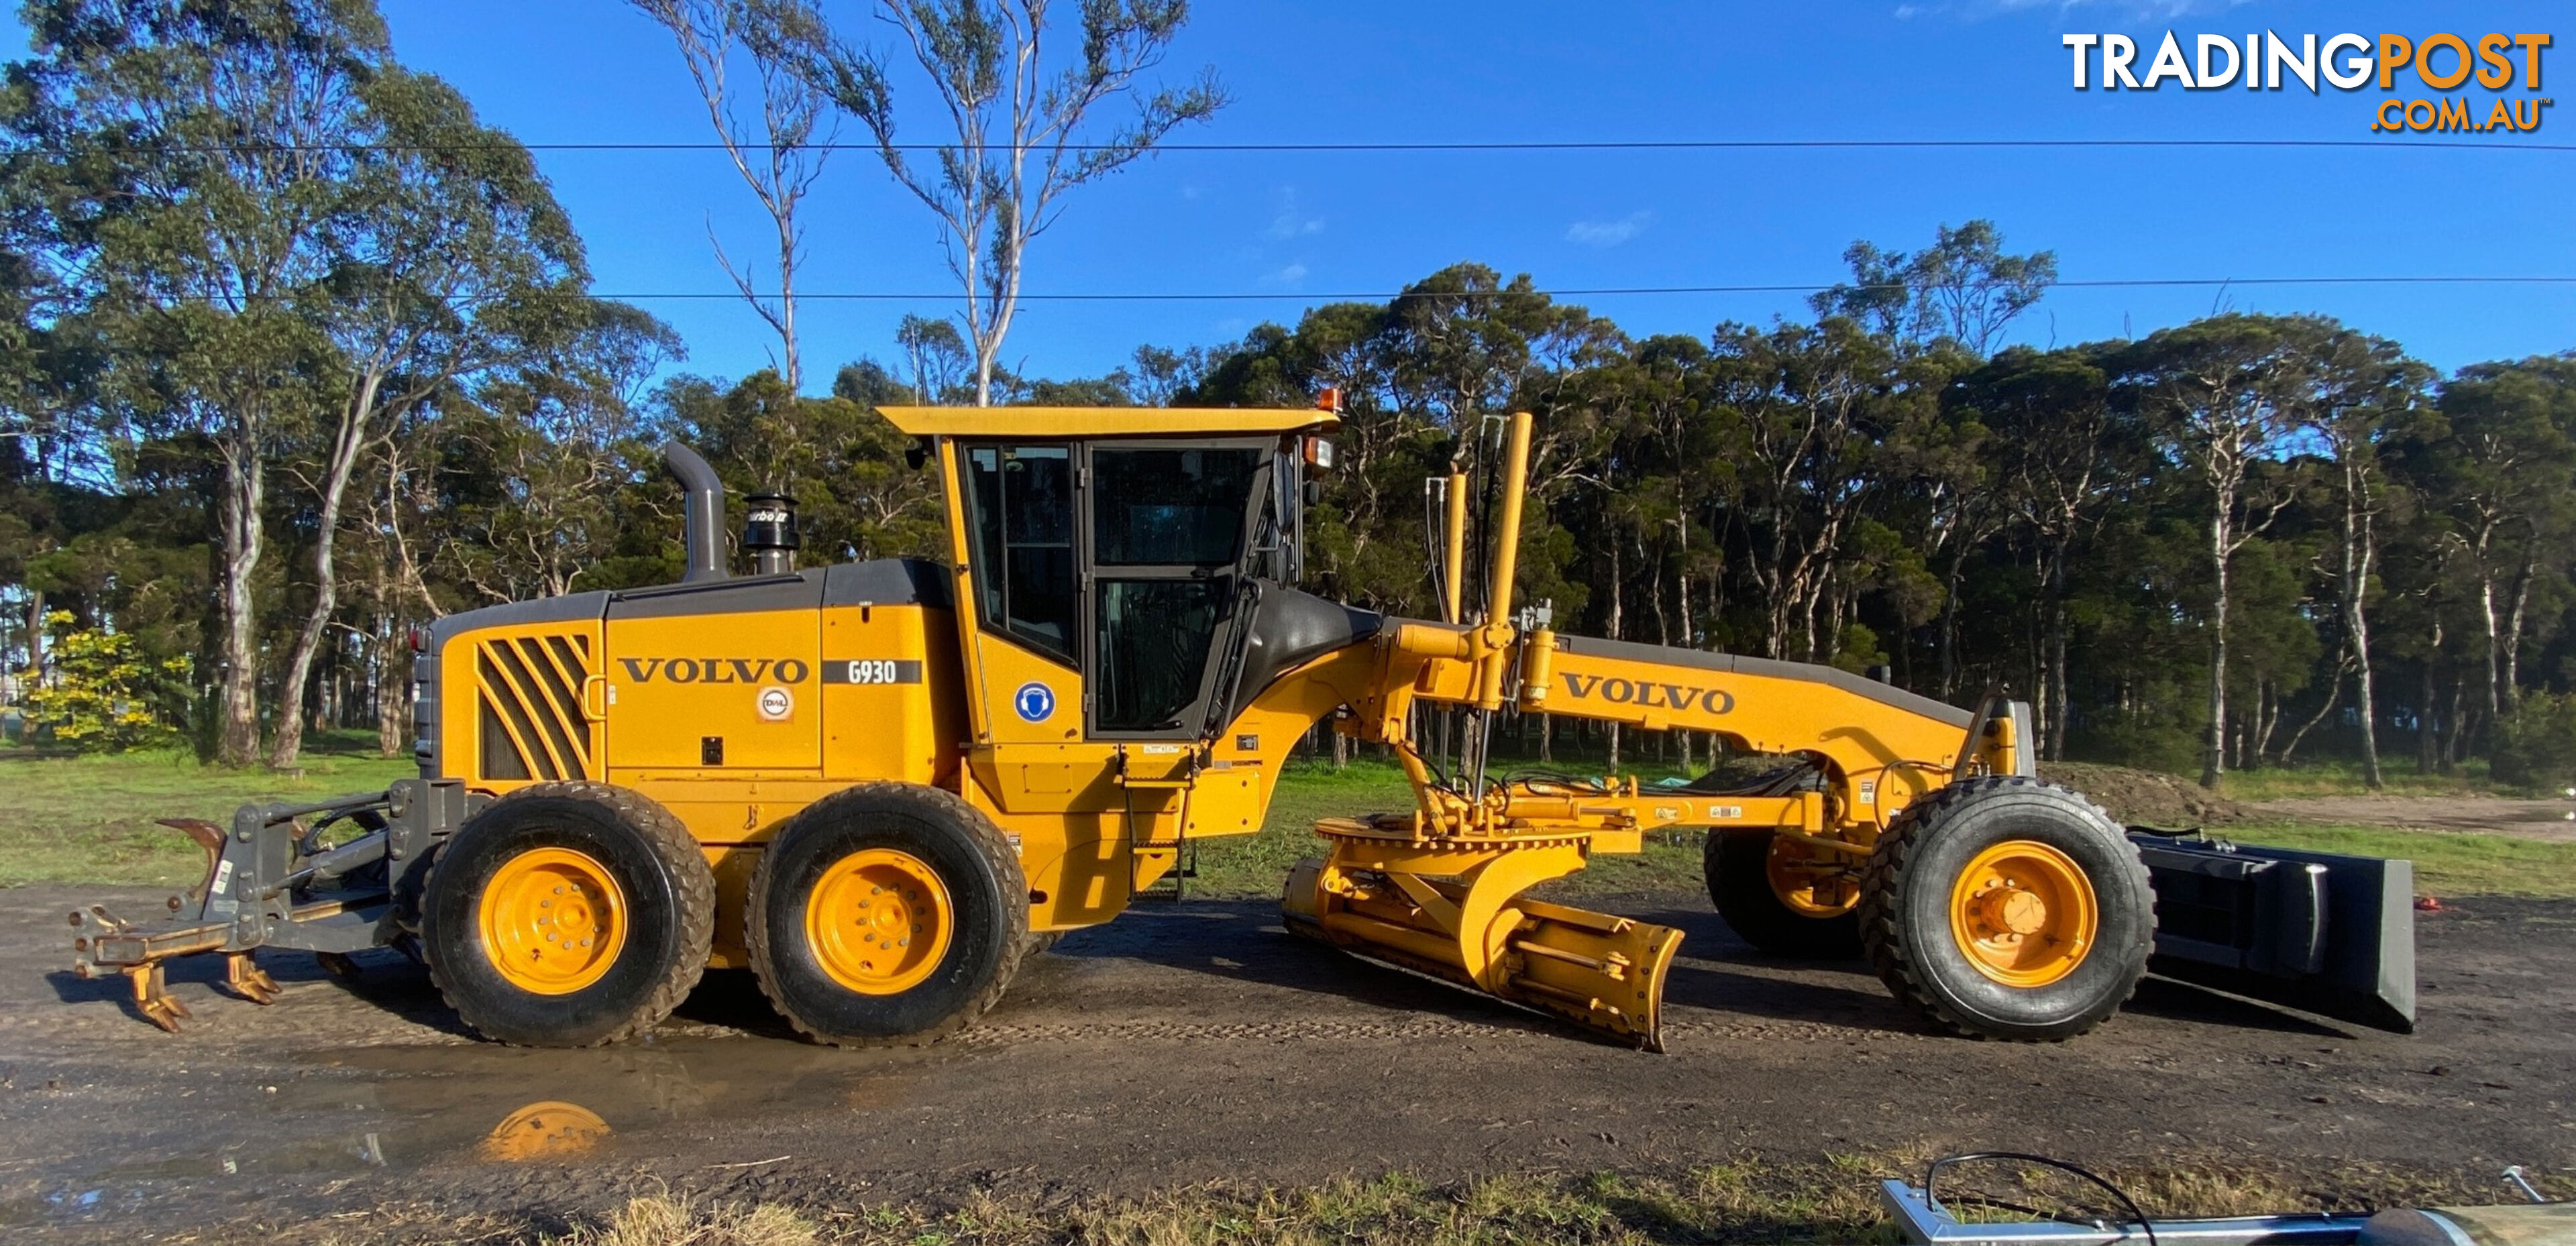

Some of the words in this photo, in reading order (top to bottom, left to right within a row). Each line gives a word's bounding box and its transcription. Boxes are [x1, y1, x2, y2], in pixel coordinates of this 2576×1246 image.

[617, 658, 809, 683] VOLVO
[848, 660, 896, 683] G930
[1559, 672, 1735, 715] VOLVO
